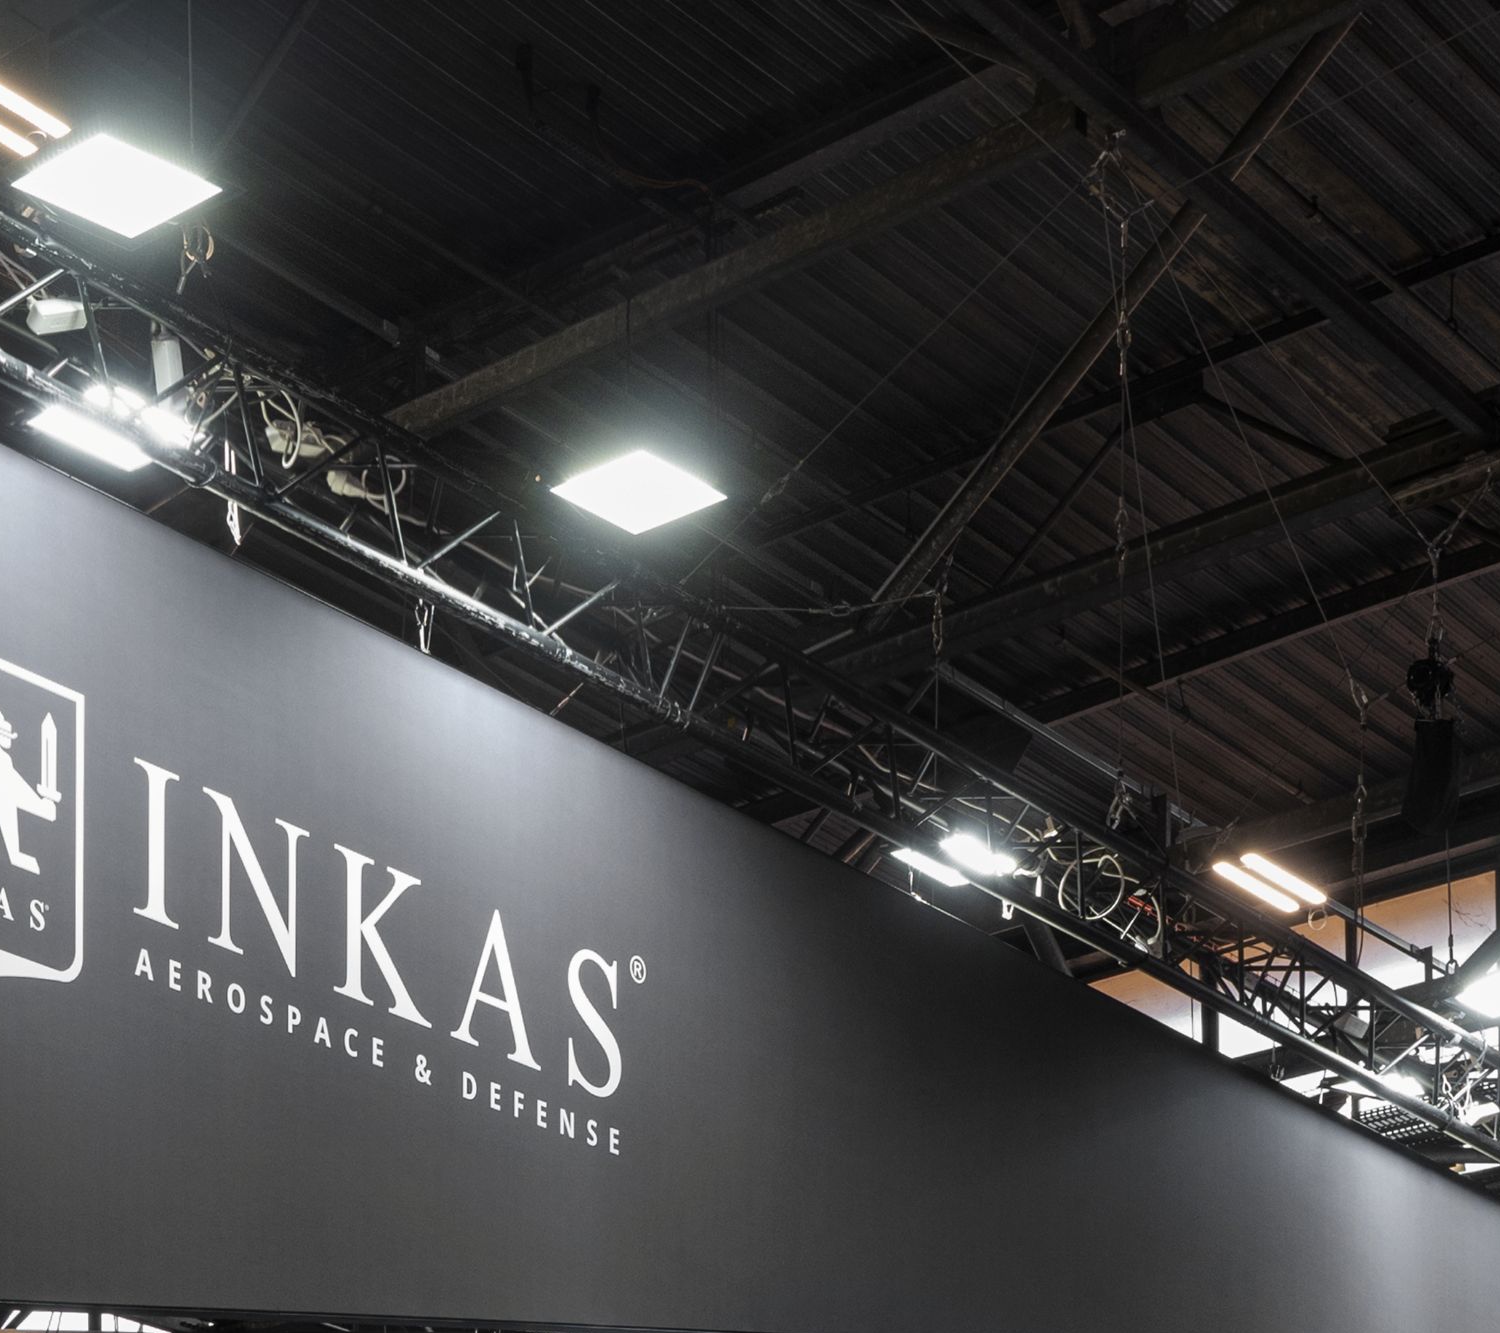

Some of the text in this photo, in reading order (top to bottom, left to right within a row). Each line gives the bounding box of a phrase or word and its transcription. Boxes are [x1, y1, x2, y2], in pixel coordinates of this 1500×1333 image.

[135, 948, 621, 1155] AEROSPACE & DEFENSE
